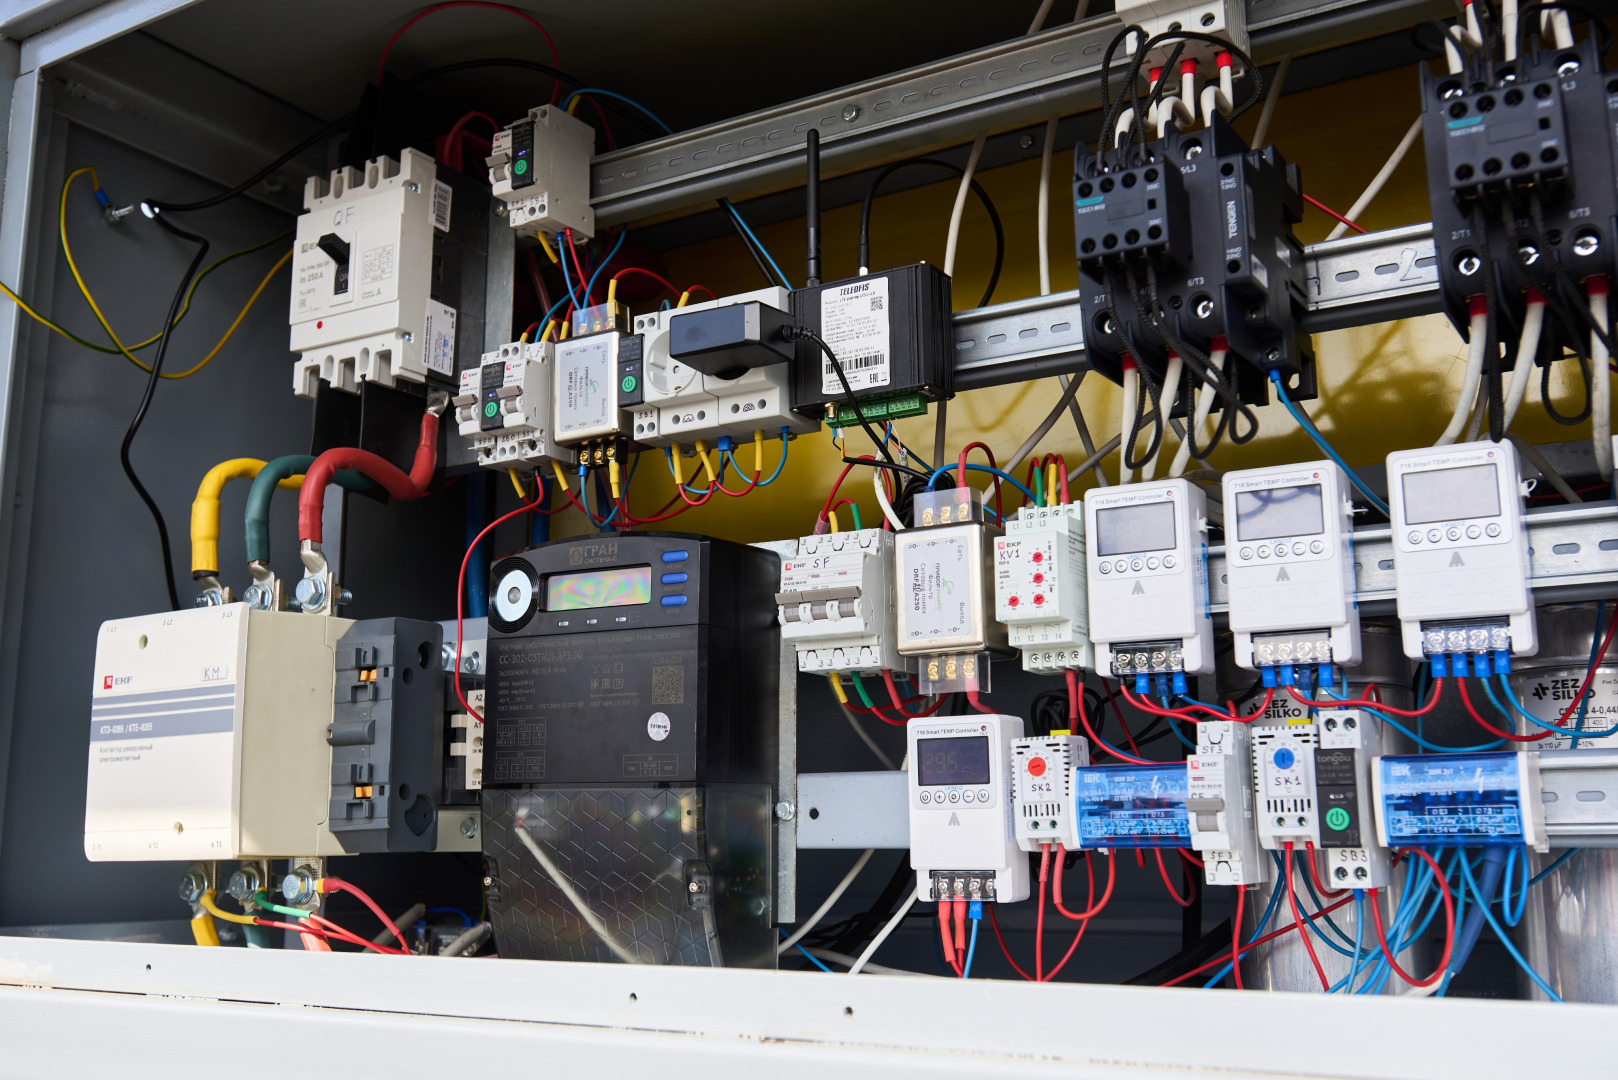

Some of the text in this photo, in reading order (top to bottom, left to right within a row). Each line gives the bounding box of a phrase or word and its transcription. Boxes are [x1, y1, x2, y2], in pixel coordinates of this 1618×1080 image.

[1180, 164, 1196, 174] 5/L3
[530, 195, 545, 205] SB2
[333, 206, 355, 226] QF
[1226, 200, 1238, 239] TENGEN
[1451, 229, 1471, 240] 2/T1
[1400, 247, 1422, 281] 2
[307, 273, 319, 282] 250
[1187, 276, 1204, 287] 6/T3
[839, 282, 870, 296] TELEOFIS
[638, 409, 654, 420] SB1
[1412, 460, 1431, 468] Smart
[1452, 455, 1484, 463] Controller
[1281, 475, 1310, 484] Controller
[1105, 497, 1121, 505] Smart
[1137, 493, 1164, 501] Controller
[583, 542, 618, 557] ГРАН
[999, 548, 1020, 561] KV1
[812, 556, 830, 569] SF
[1014, 632, 1062, 643] 11 12 13 14
[203, 666, 220, 680] KM
[114, 675, 134, 685] EKF
[1551, 678, 1580, 690] ZEZ
[475, 694, 483, 702] A2
[1268, 698, 1288, 709] EZ
[1264, 706, 1302, 719] SILKO
[99, 743, 153, 754] Контактор реверсивный
[1202, 745, 1223, 754] SF3
[98, 754, 141, 763] электромагнитный
[1317, 754, 1351, 765] tongou
[1391, 765, 1411, 777] IEK
[1084, 773, 1101, 784] IEK
[1274, 775, 1302, 786] SK1
[1031, 782, 1052, 792] SK2
[215, 840, 222, 848] T3
[1210, 851, 1233, 860] SF3
[1340, 849, 1368, 862] SB3
